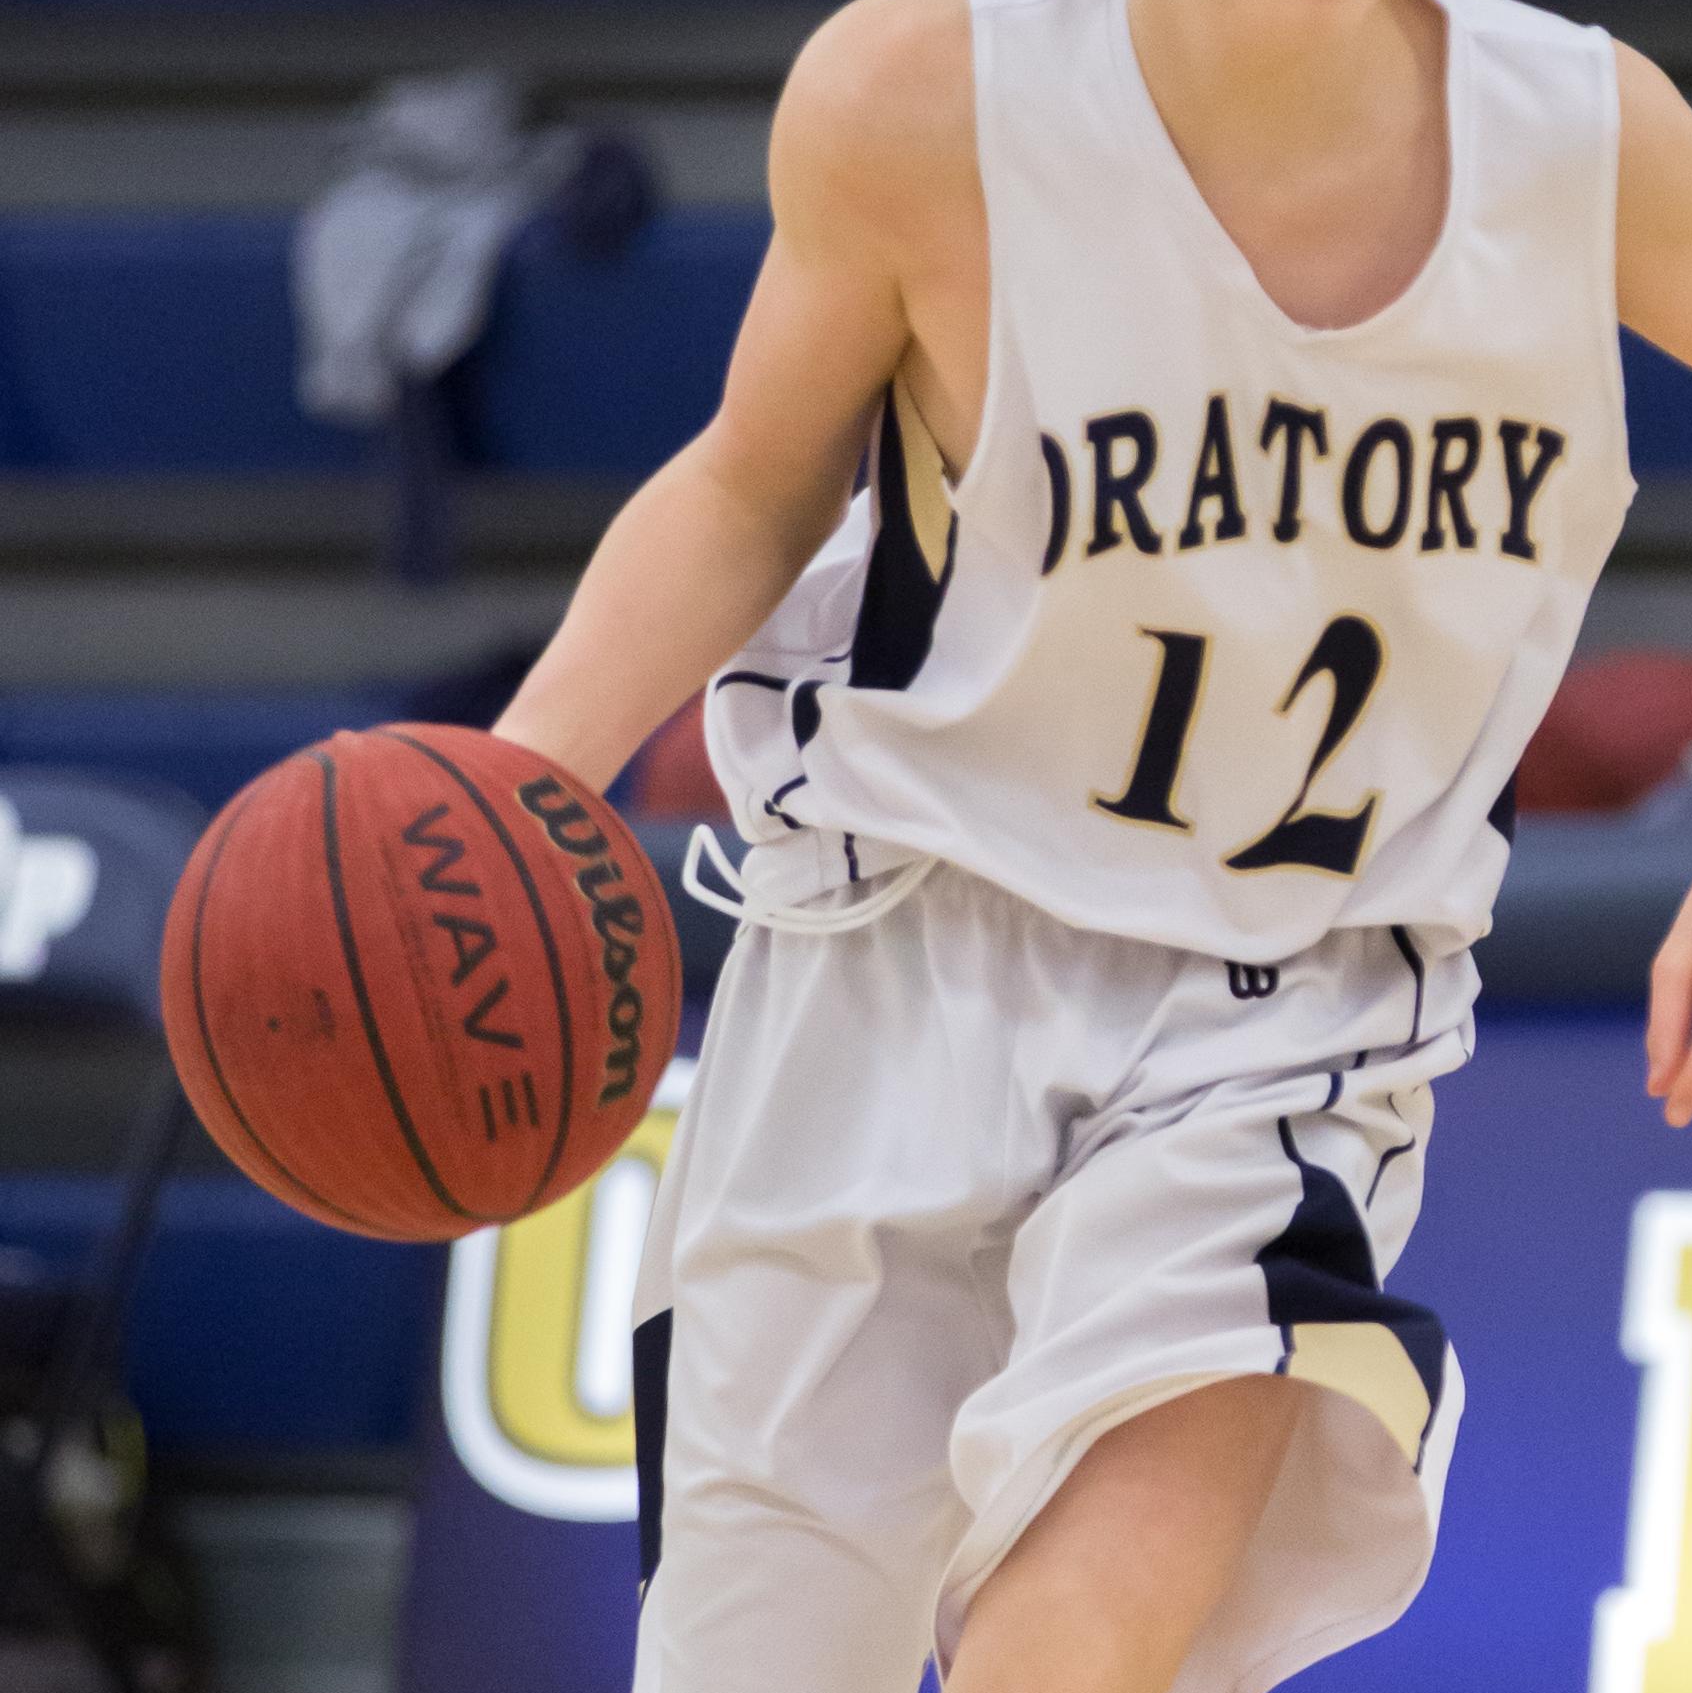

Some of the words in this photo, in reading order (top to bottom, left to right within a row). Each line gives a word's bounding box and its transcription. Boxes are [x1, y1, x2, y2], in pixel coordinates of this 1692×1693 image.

[1088, 613, 1390, 880] 12
[404, 801, 541, 1143] WAVE
[514, 772, 645, 1111] Wilson
